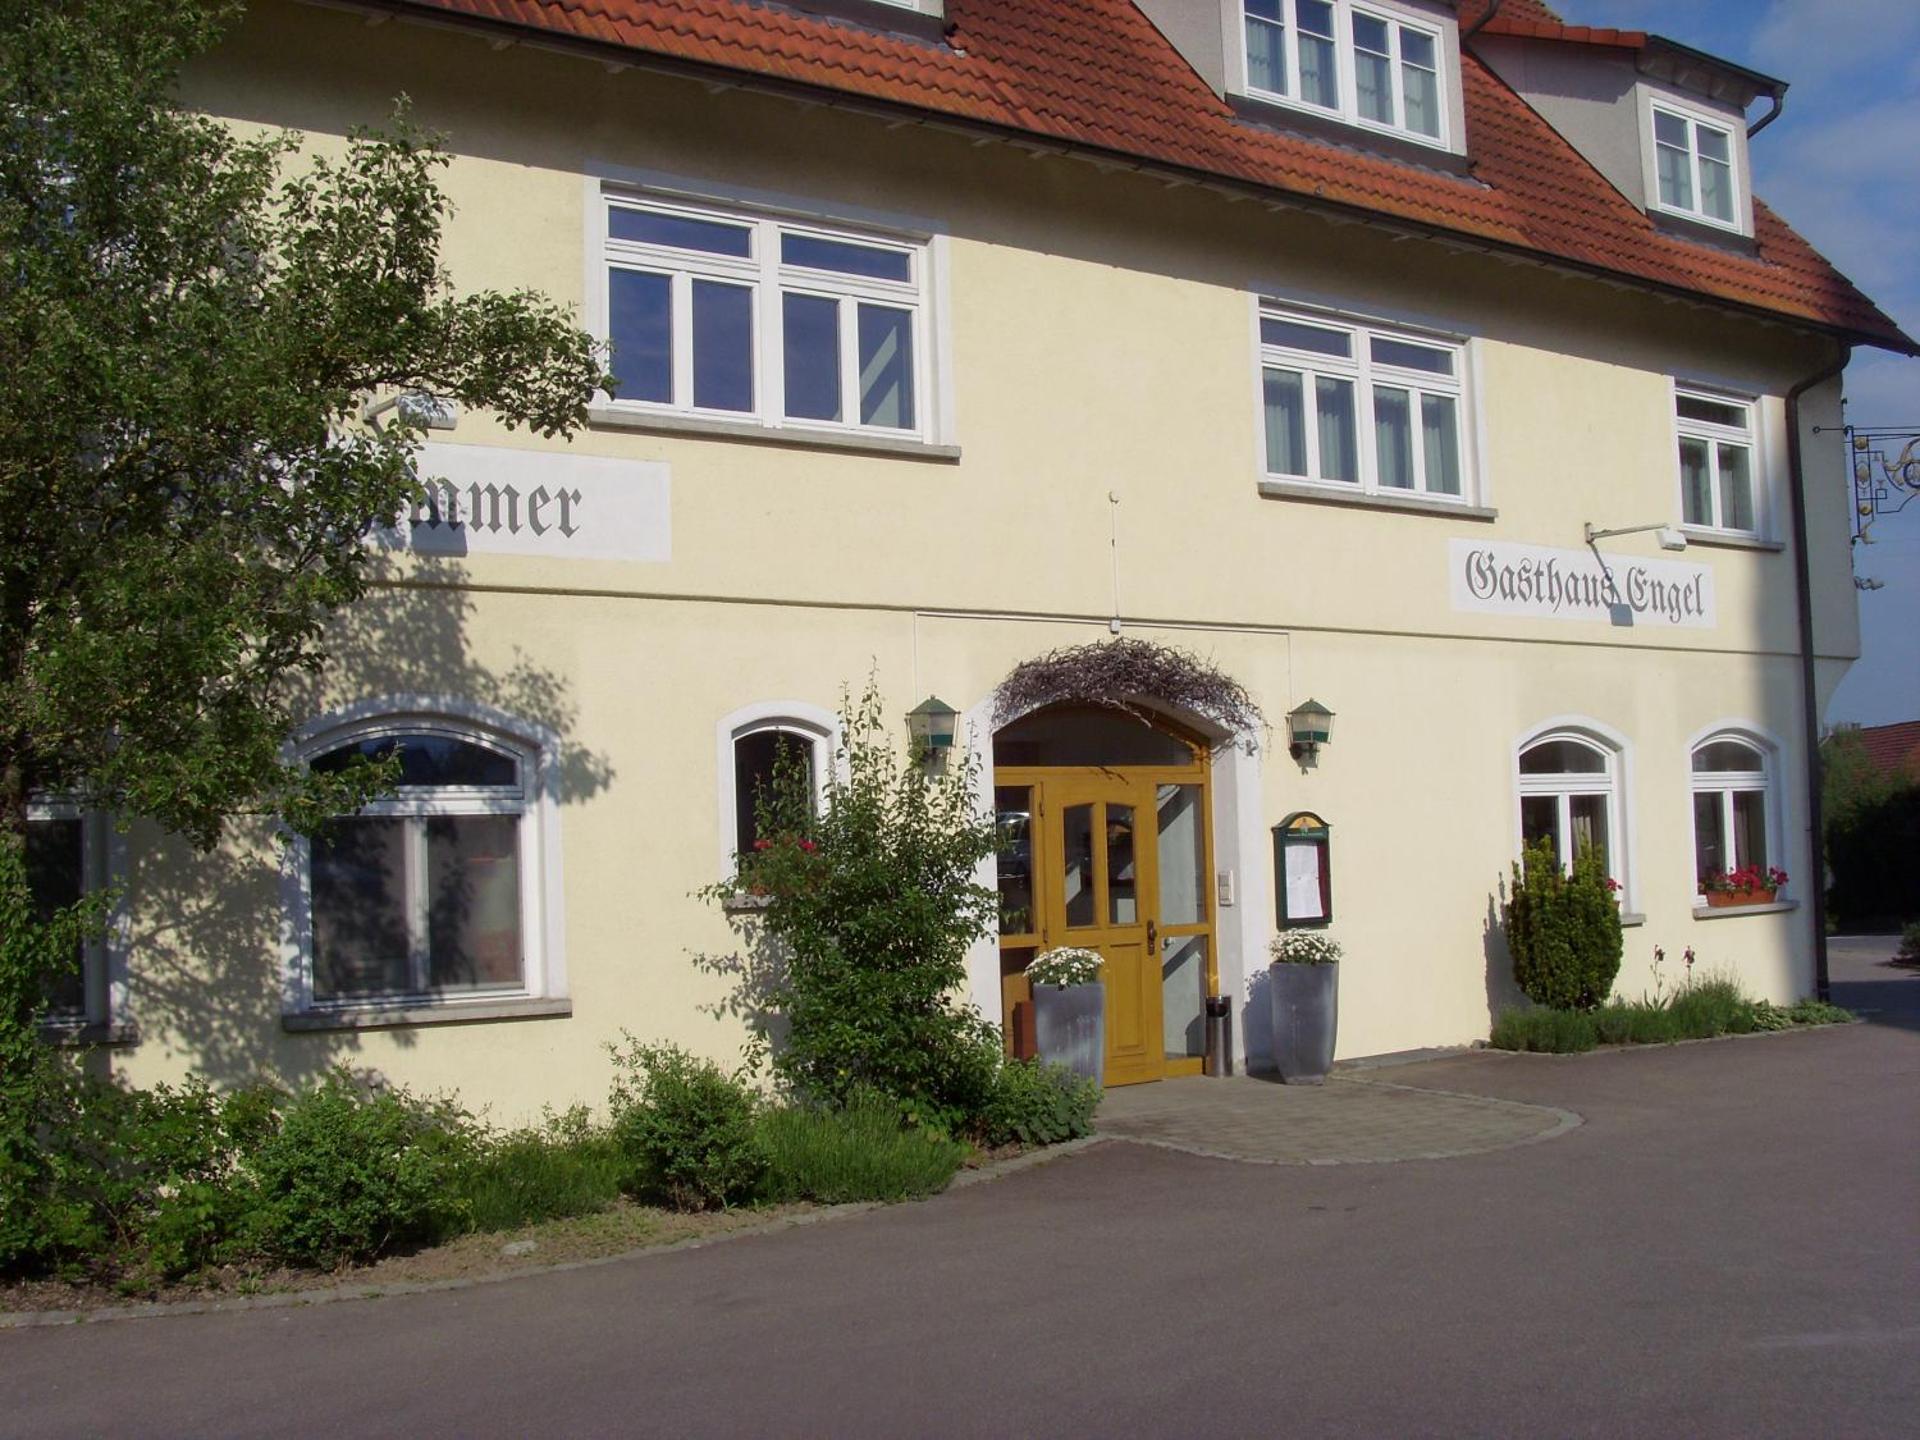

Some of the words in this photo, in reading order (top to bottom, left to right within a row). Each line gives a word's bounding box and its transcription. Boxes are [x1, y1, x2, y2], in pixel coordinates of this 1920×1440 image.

[409, 478, 582, 538] mmer
[1465, 550, 1615, 613] Gasthaus
[1626, 566, 1705, 624] Engel
